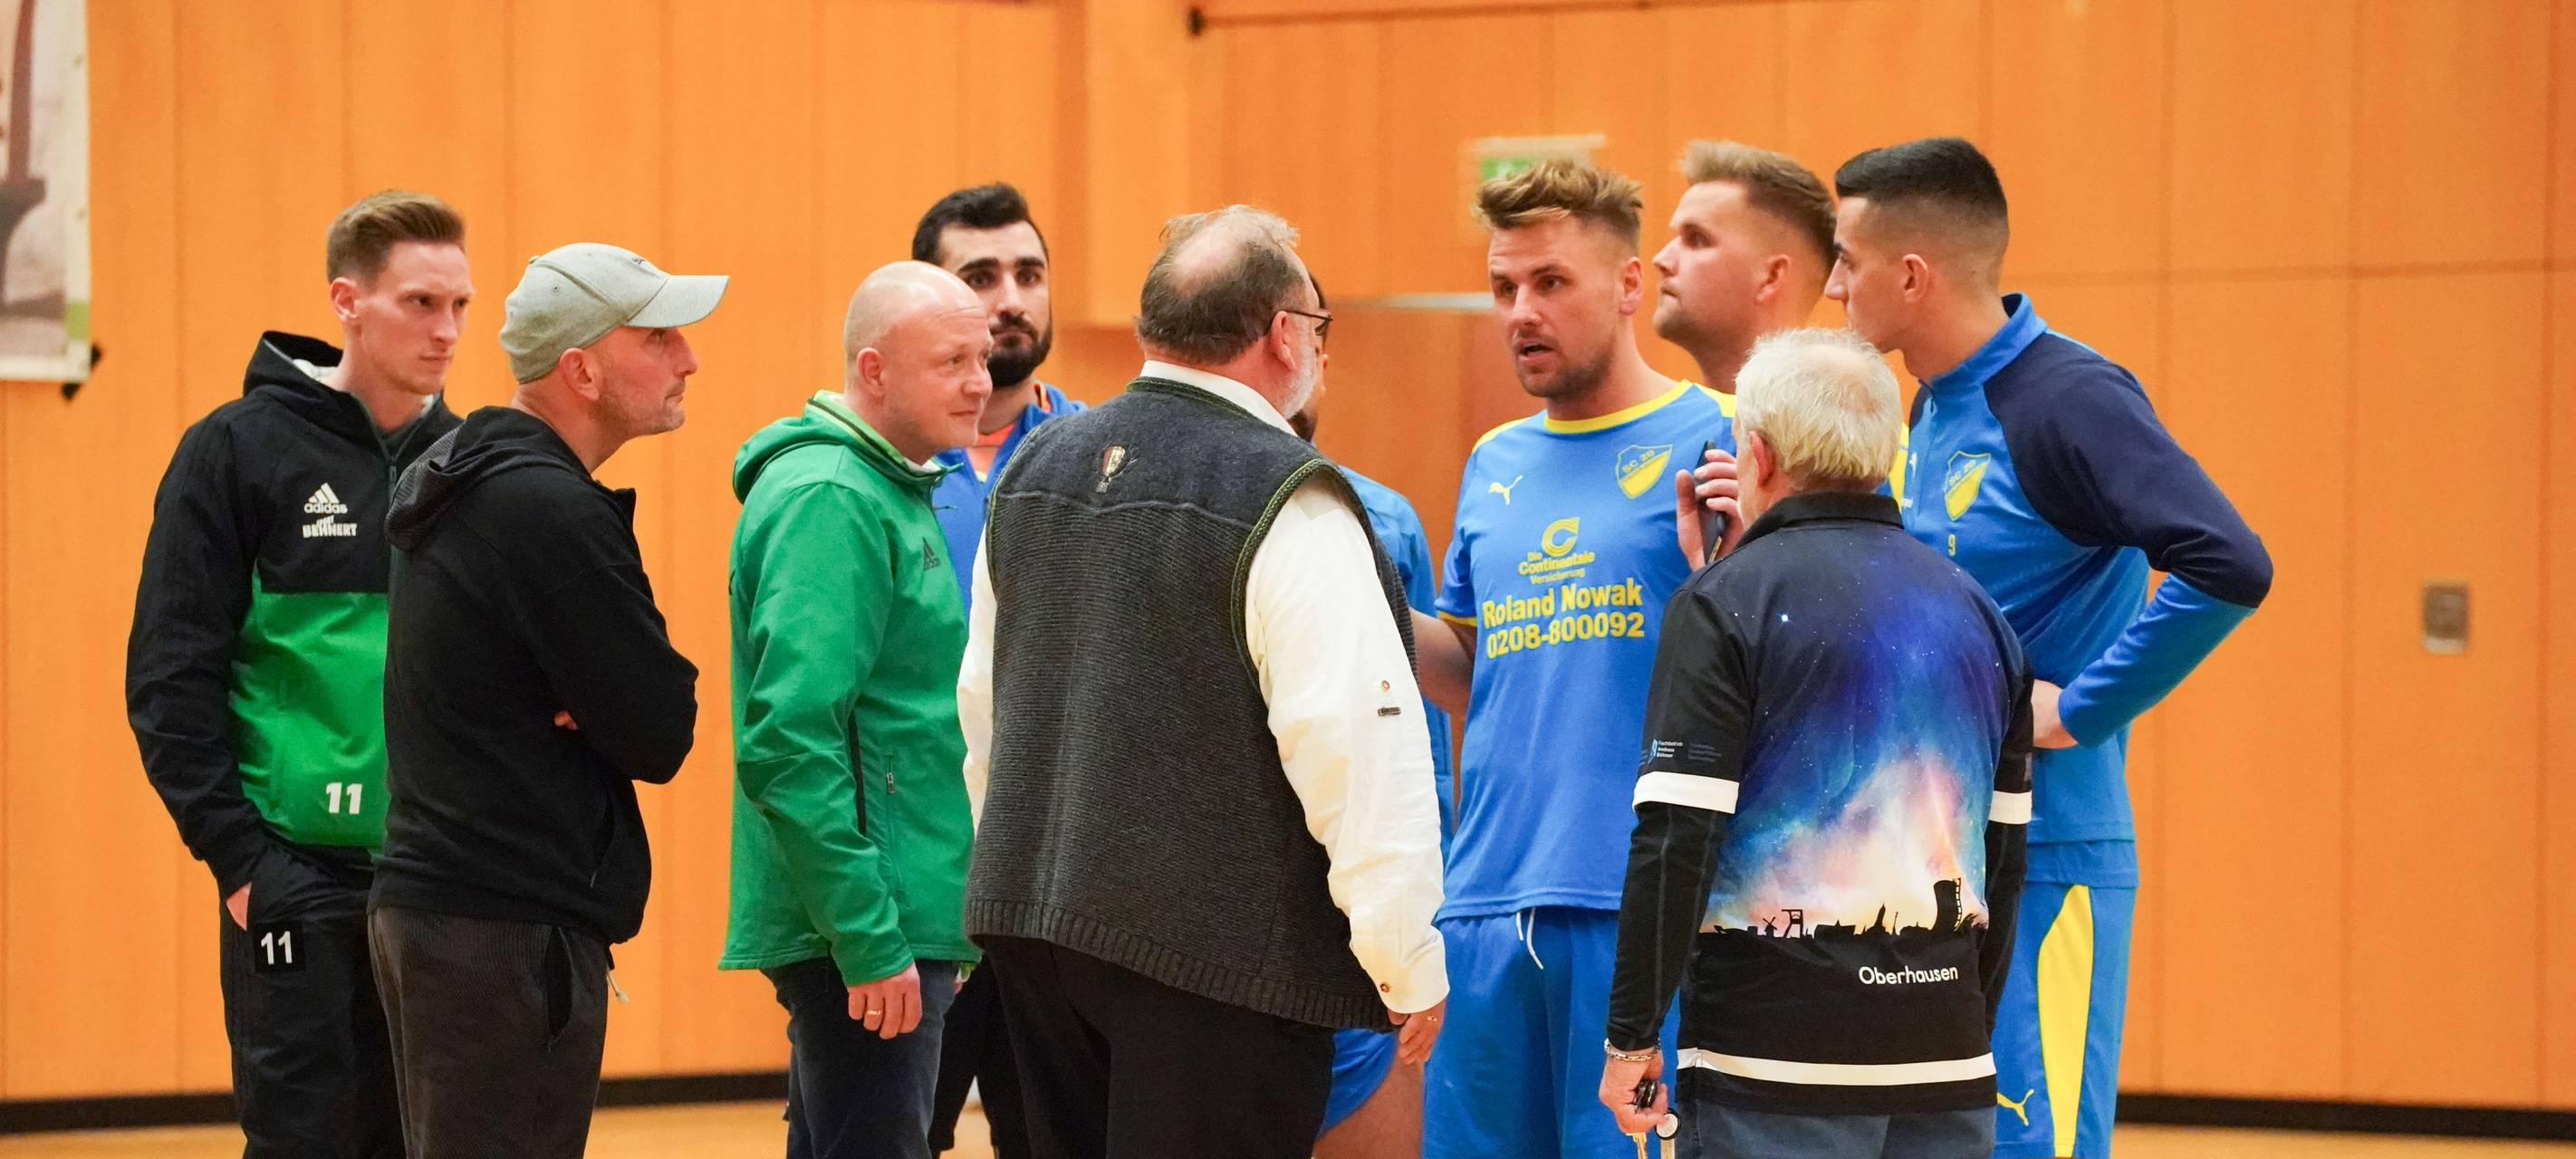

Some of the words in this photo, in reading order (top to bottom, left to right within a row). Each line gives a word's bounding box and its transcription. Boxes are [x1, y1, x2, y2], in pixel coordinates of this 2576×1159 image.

[303, 503, 348, 514] adidas
[1948, 534, 1956, 556] 9
[1518, 551, 1595, 576] Continentale
[1482, 587, 1554, 629] Roland
[1561, 577, 1643, 612] Nowak
[1486, 611, 1645, 659] 0208-800092
[325, 782, 362, 814] 11
[261, 930, 293, 965] 11
[1859, 965, 1958, 985] Oberhausen
